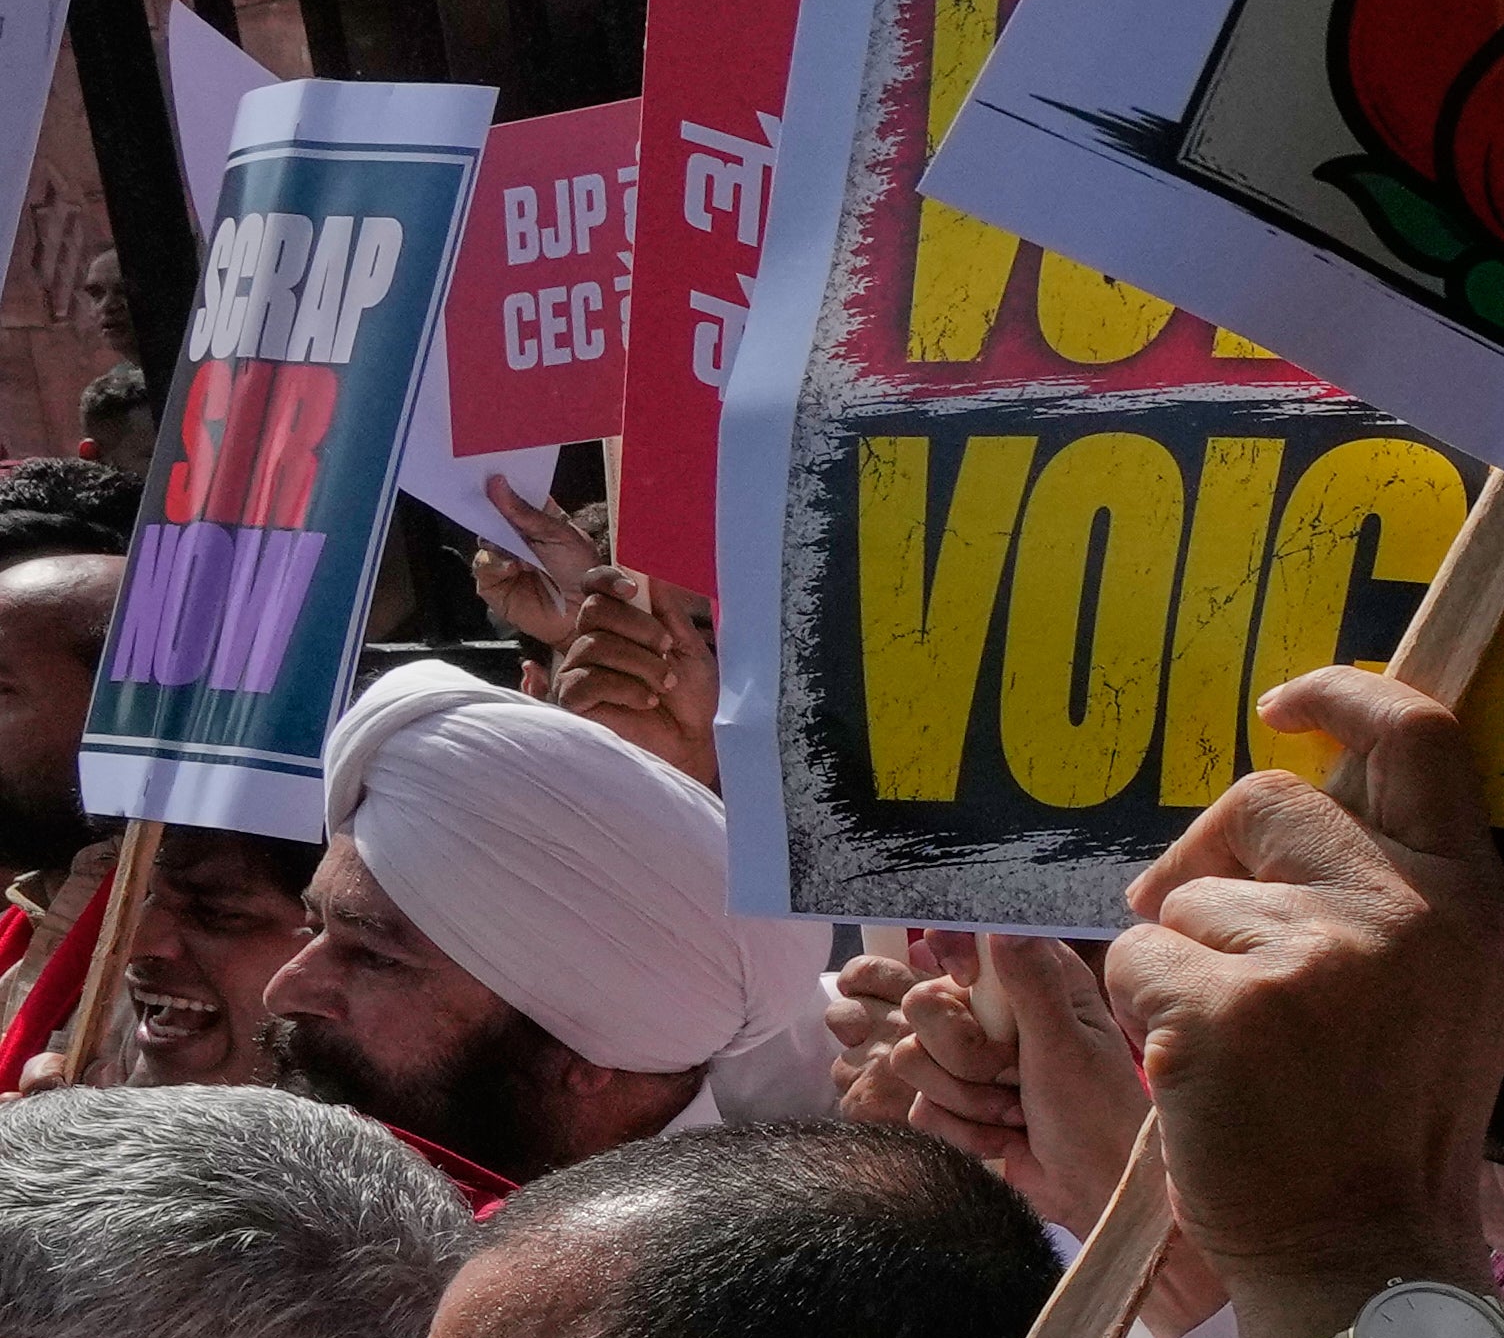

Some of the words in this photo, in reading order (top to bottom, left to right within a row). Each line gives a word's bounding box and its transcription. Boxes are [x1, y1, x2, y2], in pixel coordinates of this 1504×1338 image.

[188, 212, 403, 364] SCRAP
[503, 173, 607, 266] BJP
[503, 282, 605, 371] CEC
[164, 360, 338, 530] SIR
[110, 521, 327, 694] NOW
